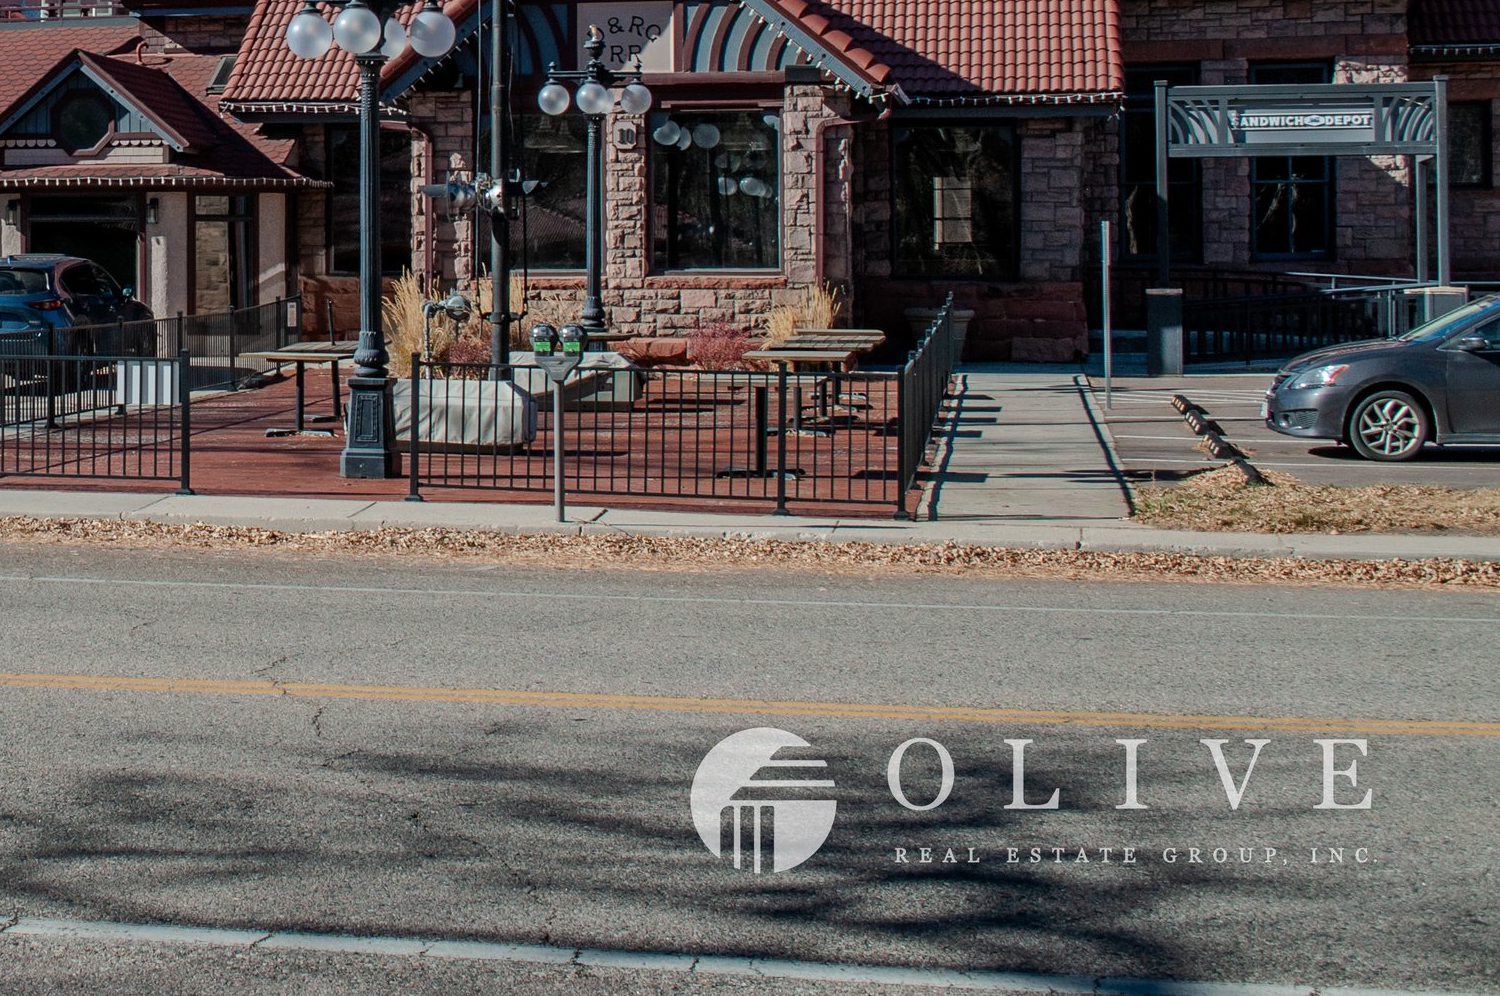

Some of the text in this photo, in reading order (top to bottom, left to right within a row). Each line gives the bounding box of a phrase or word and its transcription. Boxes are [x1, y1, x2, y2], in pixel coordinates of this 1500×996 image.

[607, 17, 625, 34] &
[1231, 112, 1304, 129] SANDWICH
[1325, 115, 1370, 126] DEPOT
[618, 128, 635, 144] 10
